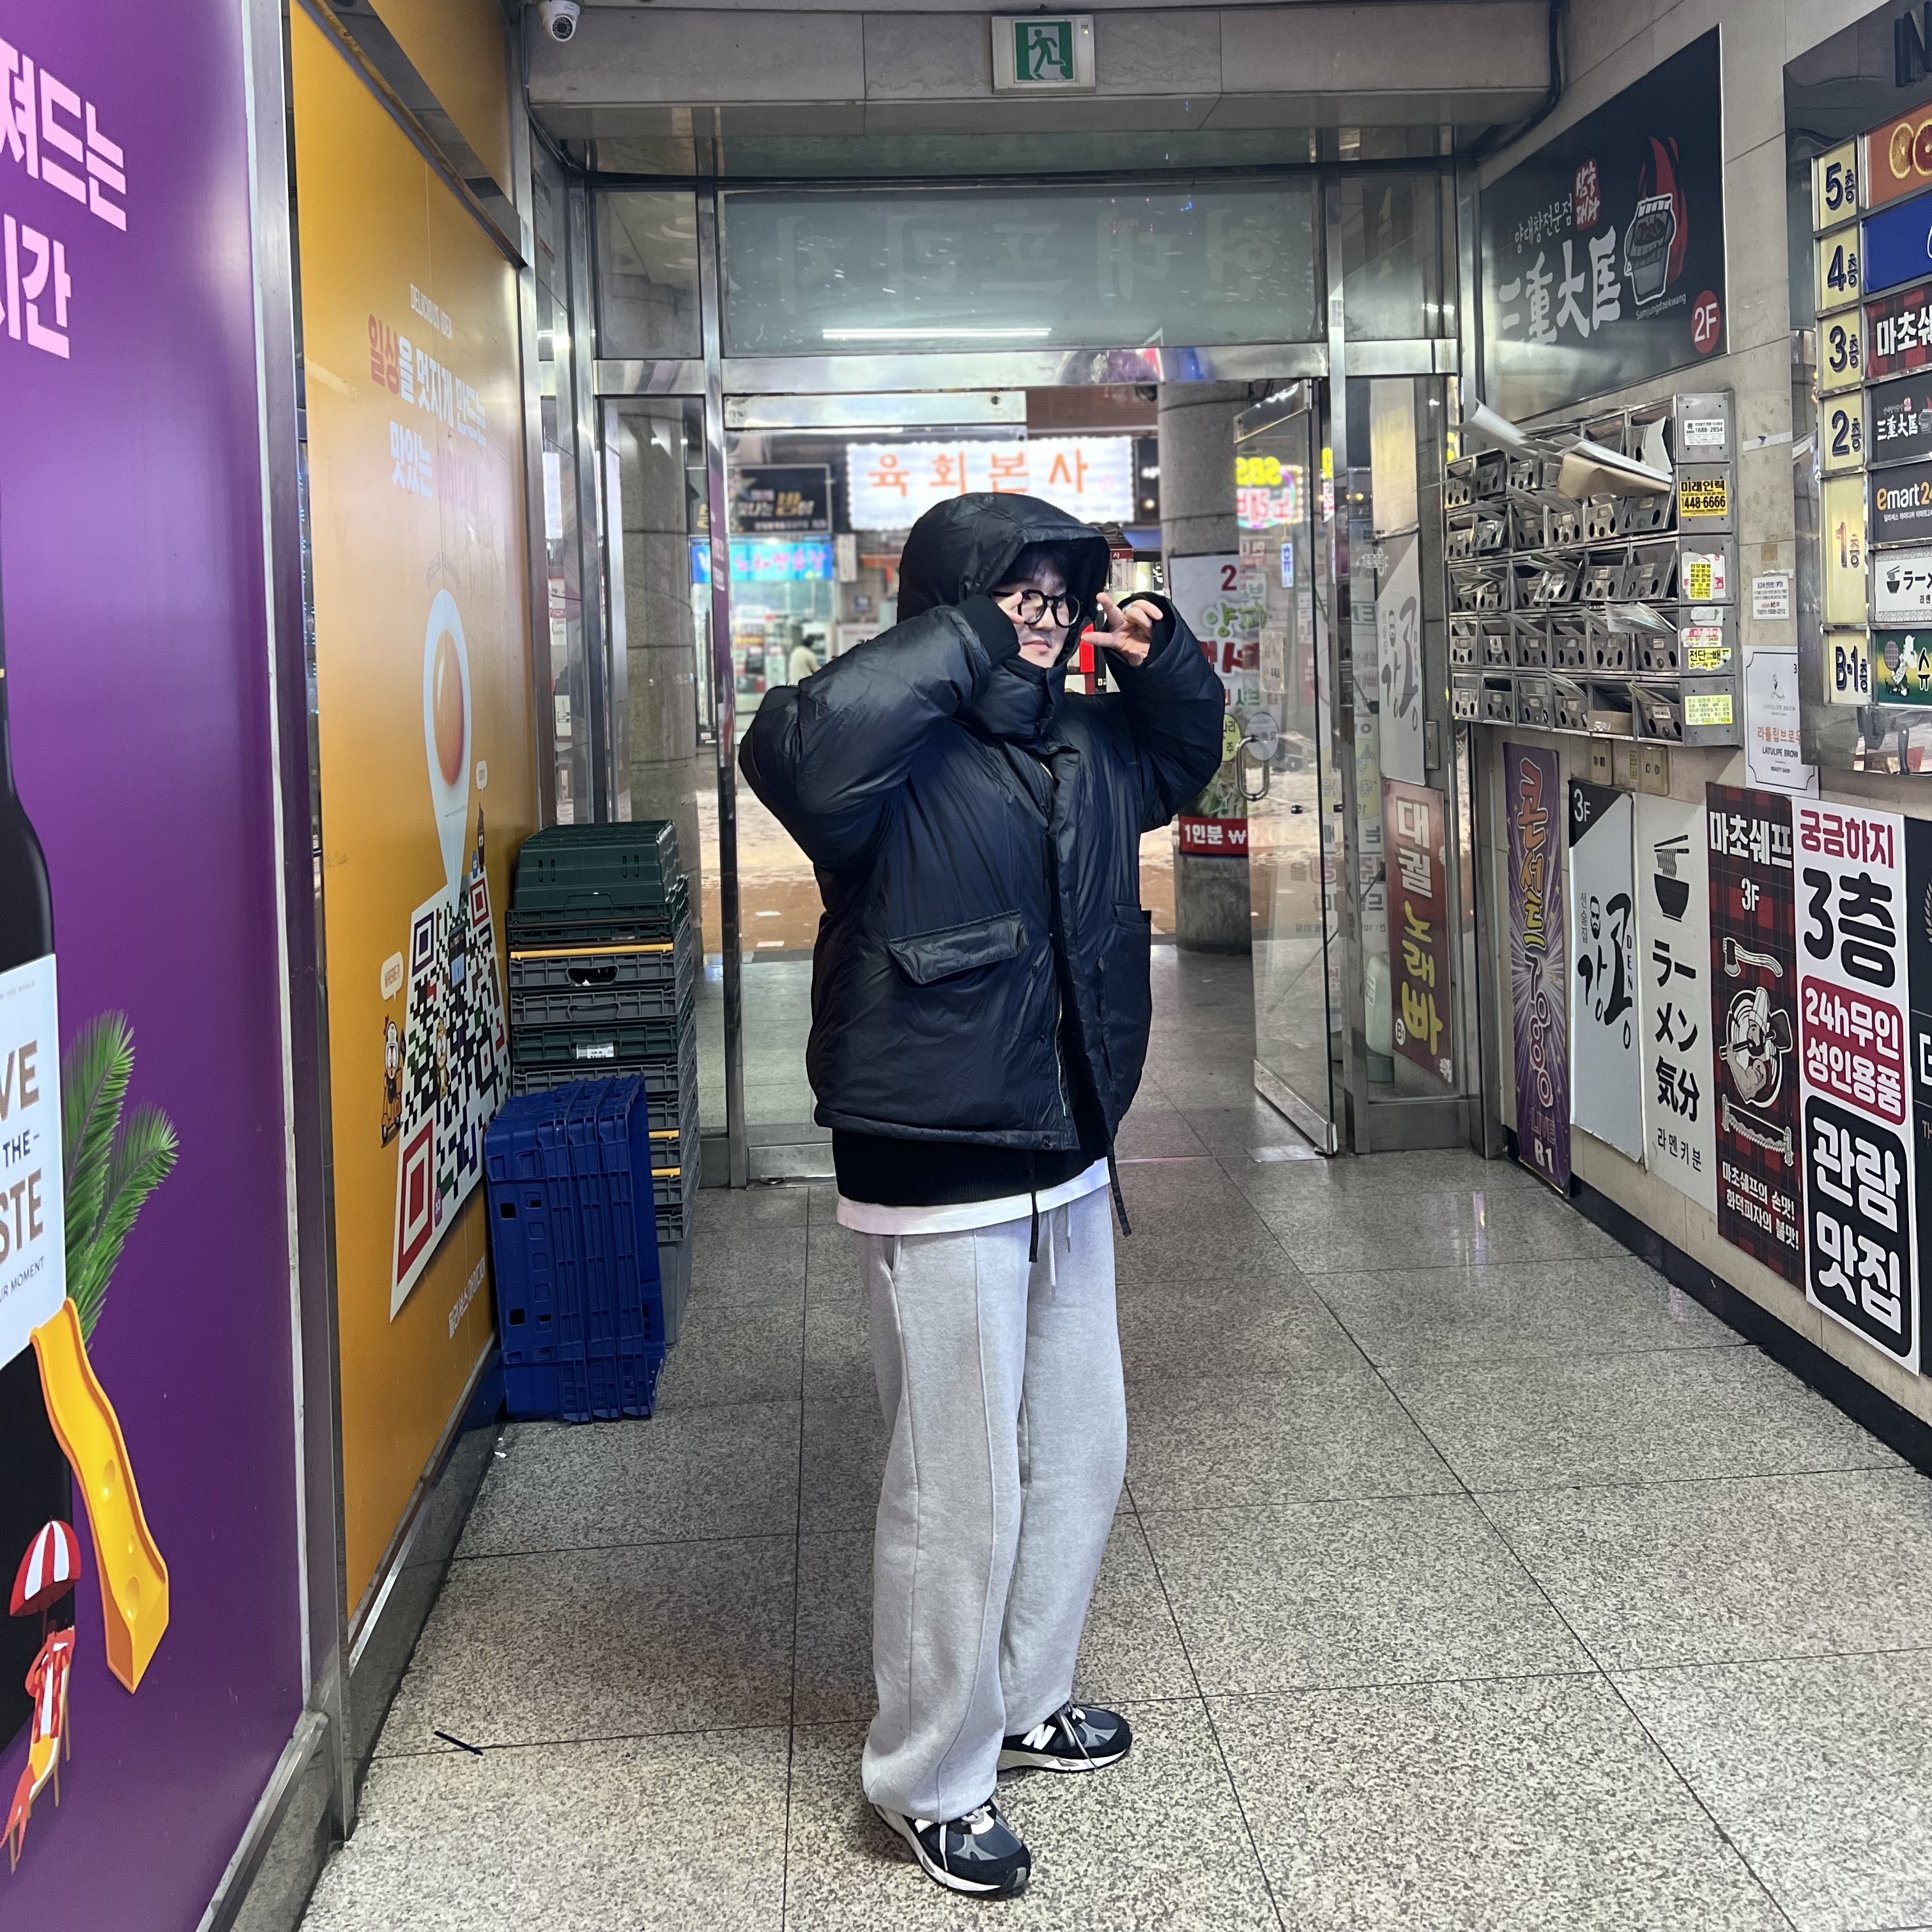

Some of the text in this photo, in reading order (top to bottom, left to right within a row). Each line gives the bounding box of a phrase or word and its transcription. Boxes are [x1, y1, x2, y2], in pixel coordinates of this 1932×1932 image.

[1825, 162, 1855, 211] 5층
[1515, 193, 1572, 254] 양대창전문점
[1827, 245, 1857, 291] 4층
[1694, 302, 1717, 342] 2F
[368, 314, 413, 404] 일상을
[416, 348, 454, 427] 멋지게
[1829, 326, 1859, 372] 3층
[1832, 410, 1862, 457] 2층
[390, 420, 433, 500] 맛있는
[868, 449, 1088, 498] 육회본사
[1682, 480, 1725, 493] 미래인력
[1685, 495, 1726, 509] 448-6666
[1877, 482, 1932, 510] emart2
[1836, 522, 1860, 569] 1층
[1918, 647, 1932, 692] 슈
[1763, 746, 1798, 759] LATULIPE BROW
[1574, 788, 1591, 823] 3F
[1184, 824, 1223, 845] 1인분
[1709, 809, 1793, 869] 마초쉐프
[1800, 809, 1894, 870] 궁금하지
[1741, 877, 1760, 912] 3F
[1802, 866, 1896, 988] 3층
[1524, 949, 1554, 1108] 7080
[1805, 986, 1899, 1061] 24h무인
[1807, 1036, 1902, 1117] 성인용품
[1533, 1137, 1554, 1175] B1
[1657, 1126, 1702, 1172] 라멘키분
[1722, 1161, 1795, 1222] 마초쉐프의 손맛!
[1813, 1116, 1901, 1234] 관람
[1726, 1188, 1772, 1234] 화덕피자의
[11, 1255, 45, 1294] MOMENT
[1816, 1211, 1902, 1335] 맛집
